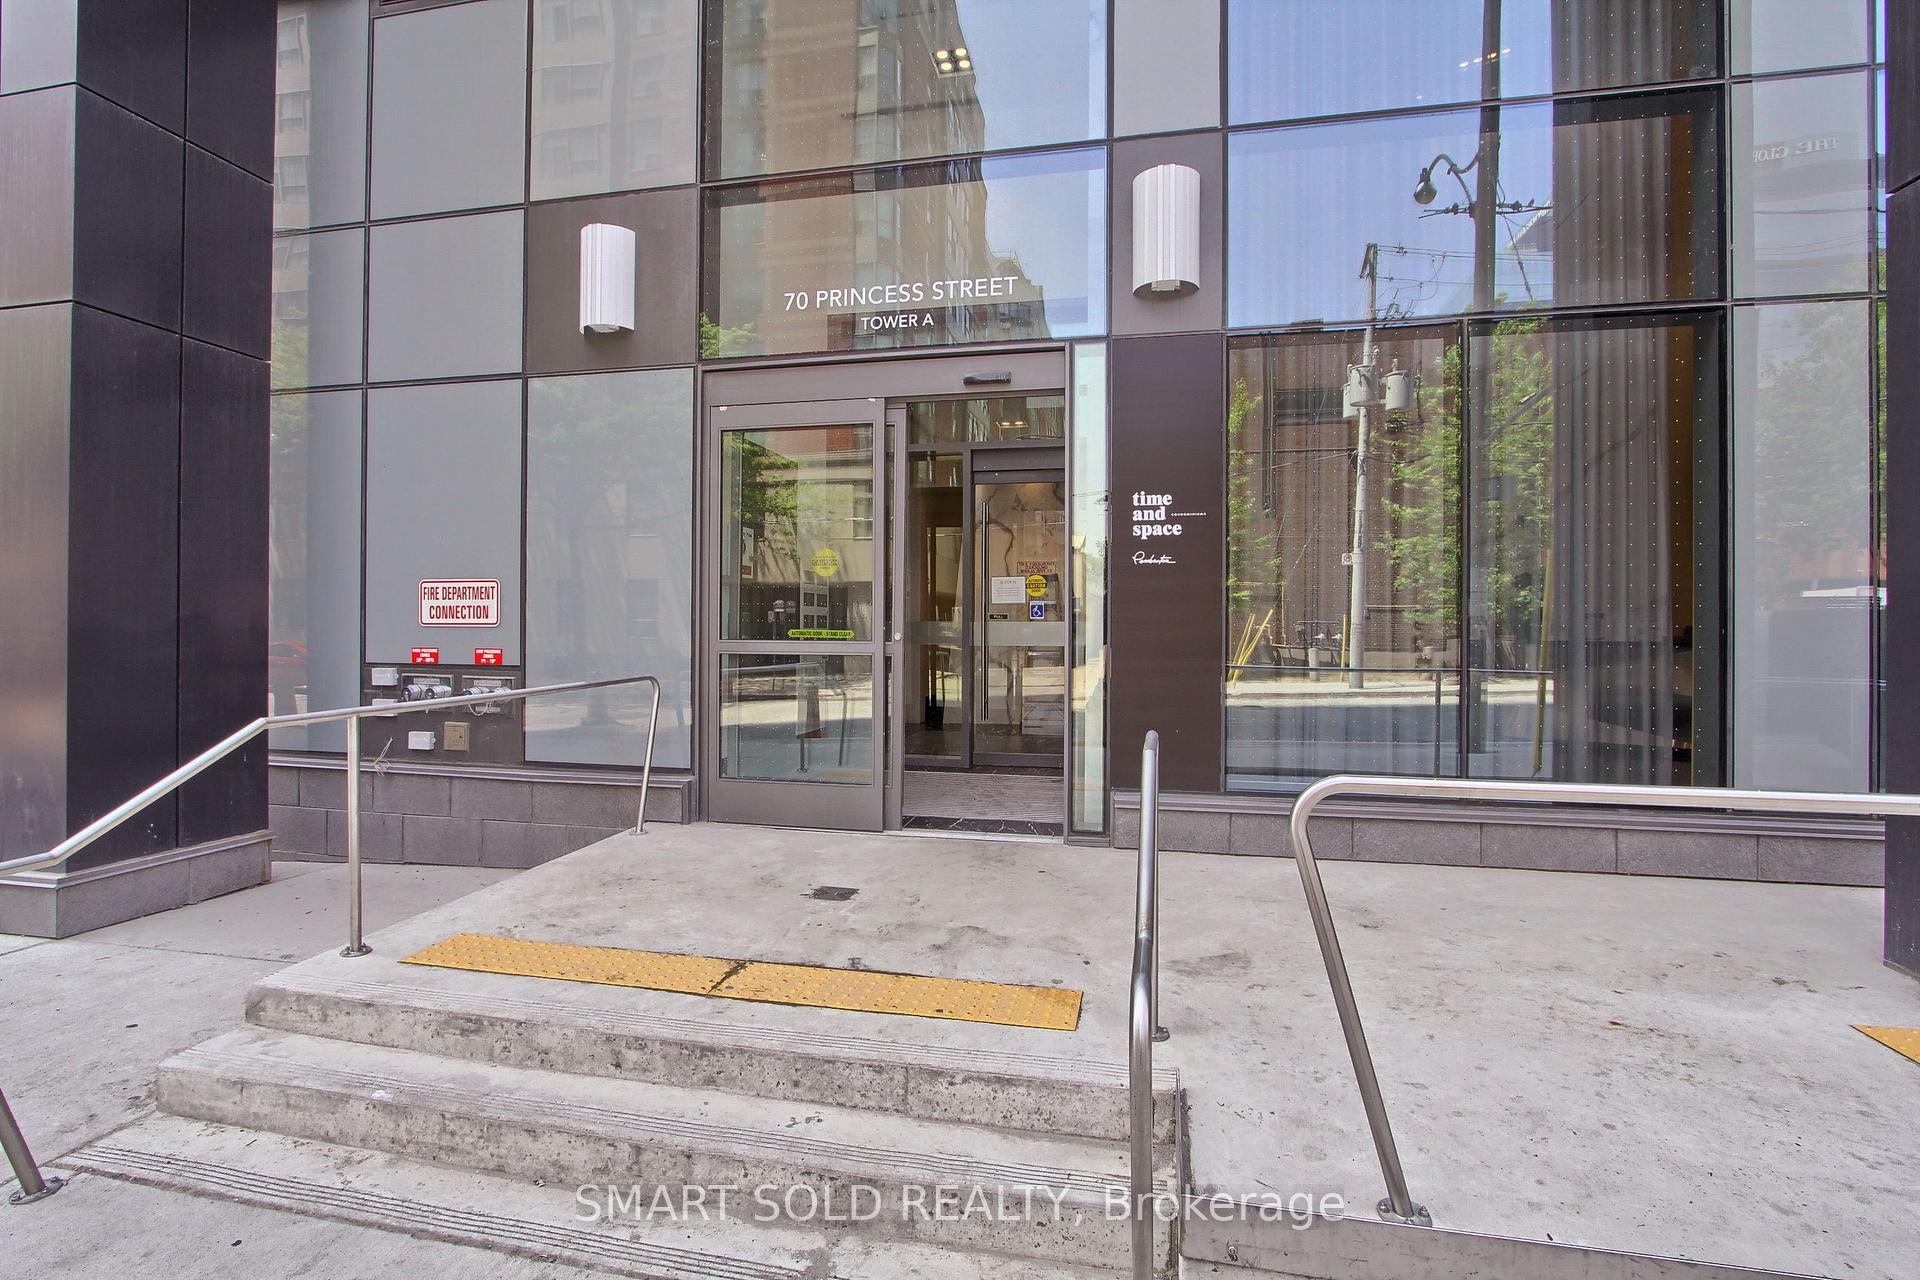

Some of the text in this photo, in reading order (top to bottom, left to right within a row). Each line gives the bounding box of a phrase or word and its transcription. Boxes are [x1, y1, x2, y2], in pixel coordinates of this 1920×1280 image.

[784, 276, 1018, 311] 70 PRINCESS STREET
[861, 313, 934, 330] TOWER A
[1132, 491, 1172, 506] time
[1132, 506, 1166, 521] and
[1132, 524, 1182, 540] space
[423, 586, 495, 601] FIRE DEPARTMENT
[429, 605, 489, 620] CONNECTION
